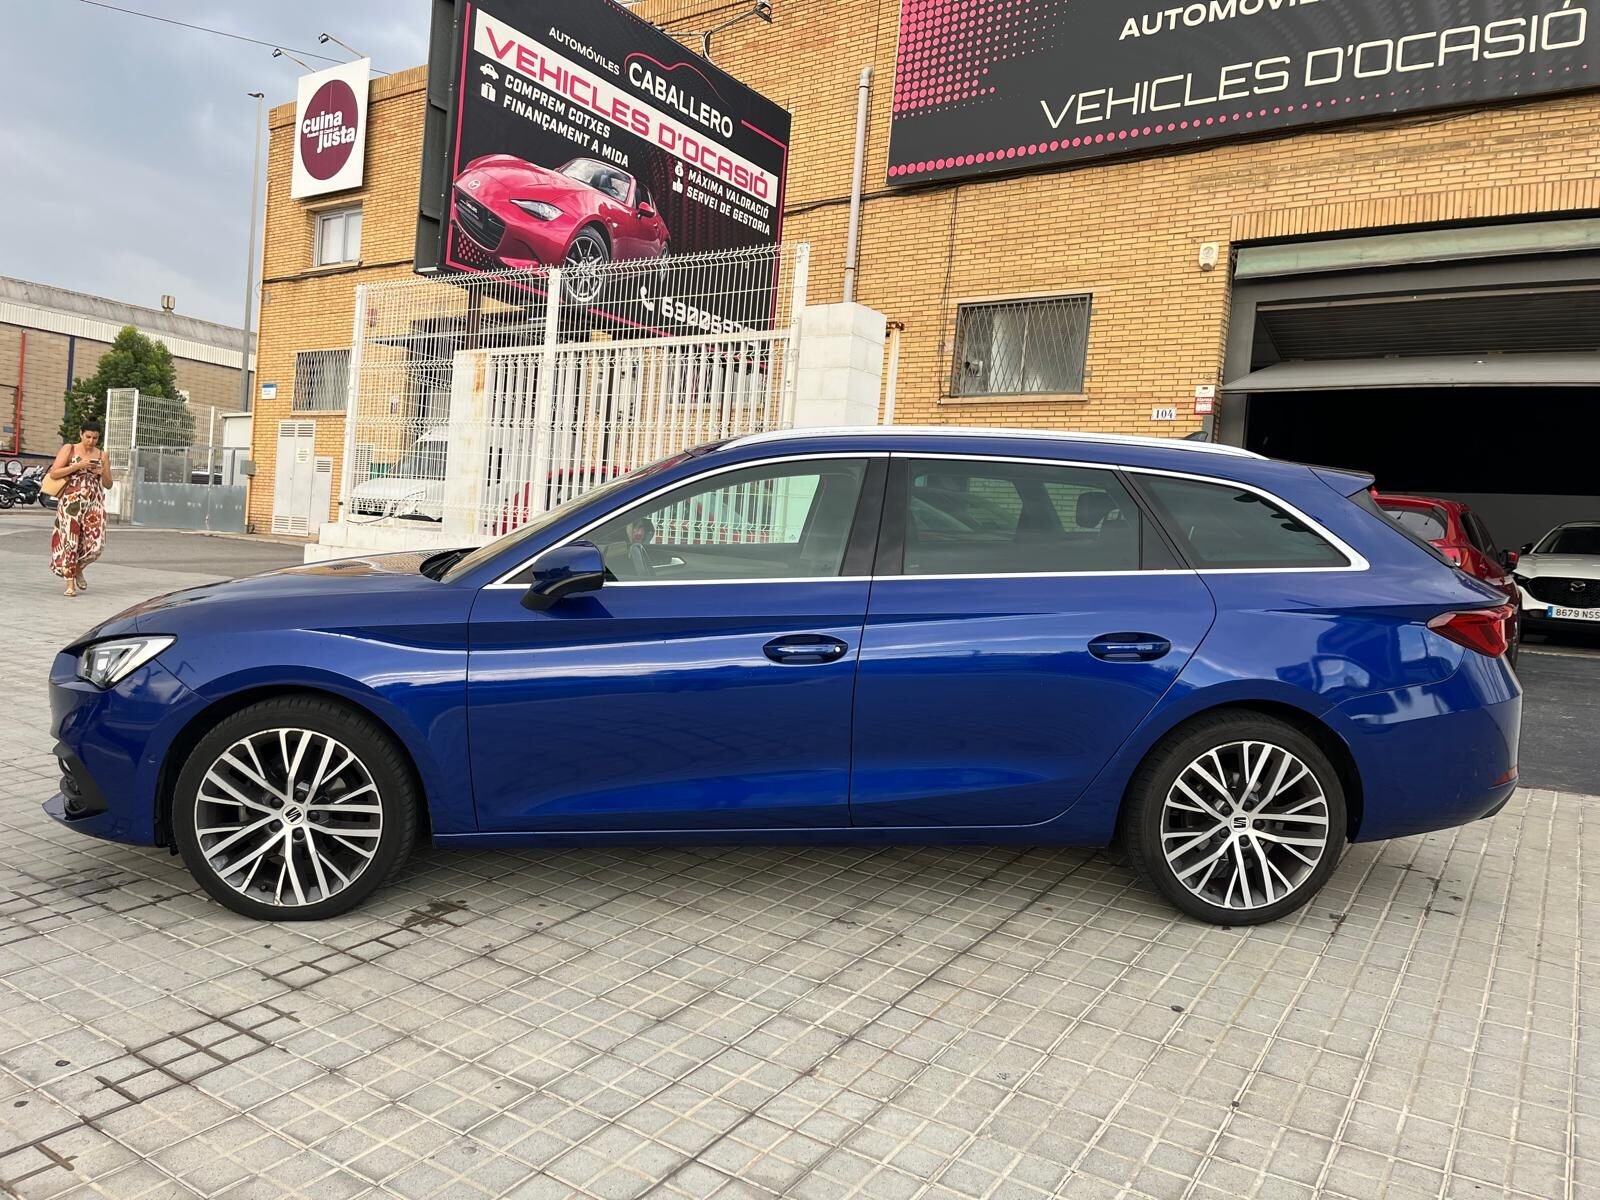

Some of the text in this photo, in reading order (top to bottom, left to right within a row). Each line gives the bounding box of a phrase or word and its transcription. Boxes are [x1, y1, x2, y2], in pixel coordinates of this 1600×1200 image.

[548, 26, 621, 76] AUTOMÓVILES
[1040, 0, 1588, 129] VEHICLES D'OCASIÓ
[302, 110, 343, 134] cuina
[486, 26, 768, 199] VEHICLES D'OCASIÓ
[504, 74, 611, 139] COMPREM COTXES
[629, 61, 734, 139] CABALLERO
[316, 126, 355, 154] justa
[503, 94, 629, 168] FINANÇAMENT A MIDA
[687, 186, 770, 236] SERVEI DE GESTORIA
[688, 169, 769, 219] MÀXIMA VALORACIÓ
[1156, 408, 1173, 419] 104
[1556, 608, 1580, 617] 8679
